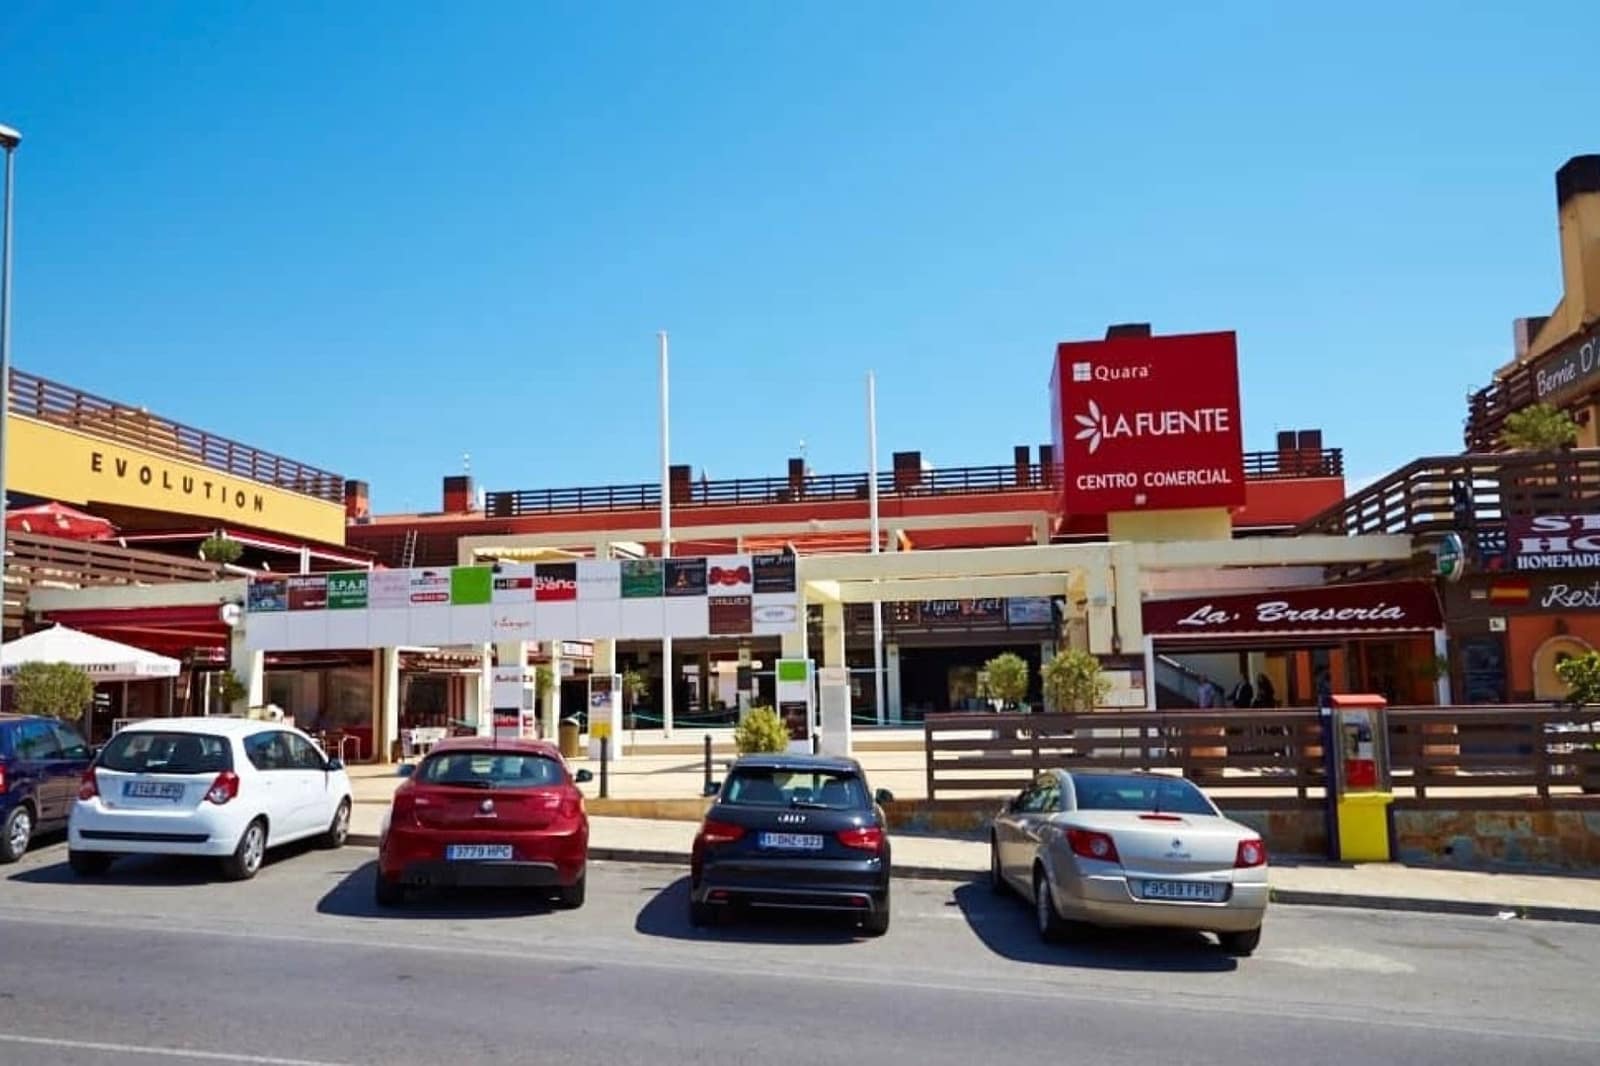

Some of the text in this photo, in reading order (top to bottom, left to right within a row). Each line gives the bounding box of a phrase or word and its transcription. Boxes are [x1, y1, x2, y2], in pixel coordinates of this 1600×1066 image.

[1095, 365, 1149, 381] Quara
[1102, 408, 1230, 439] LA FUENTE
[91, 452, 263, 512] EVOLUTION
[1077, 468, 1232, 490] CENTRO COMERCIAL
[1517, 553, 1600, 569] HOMEMADE
